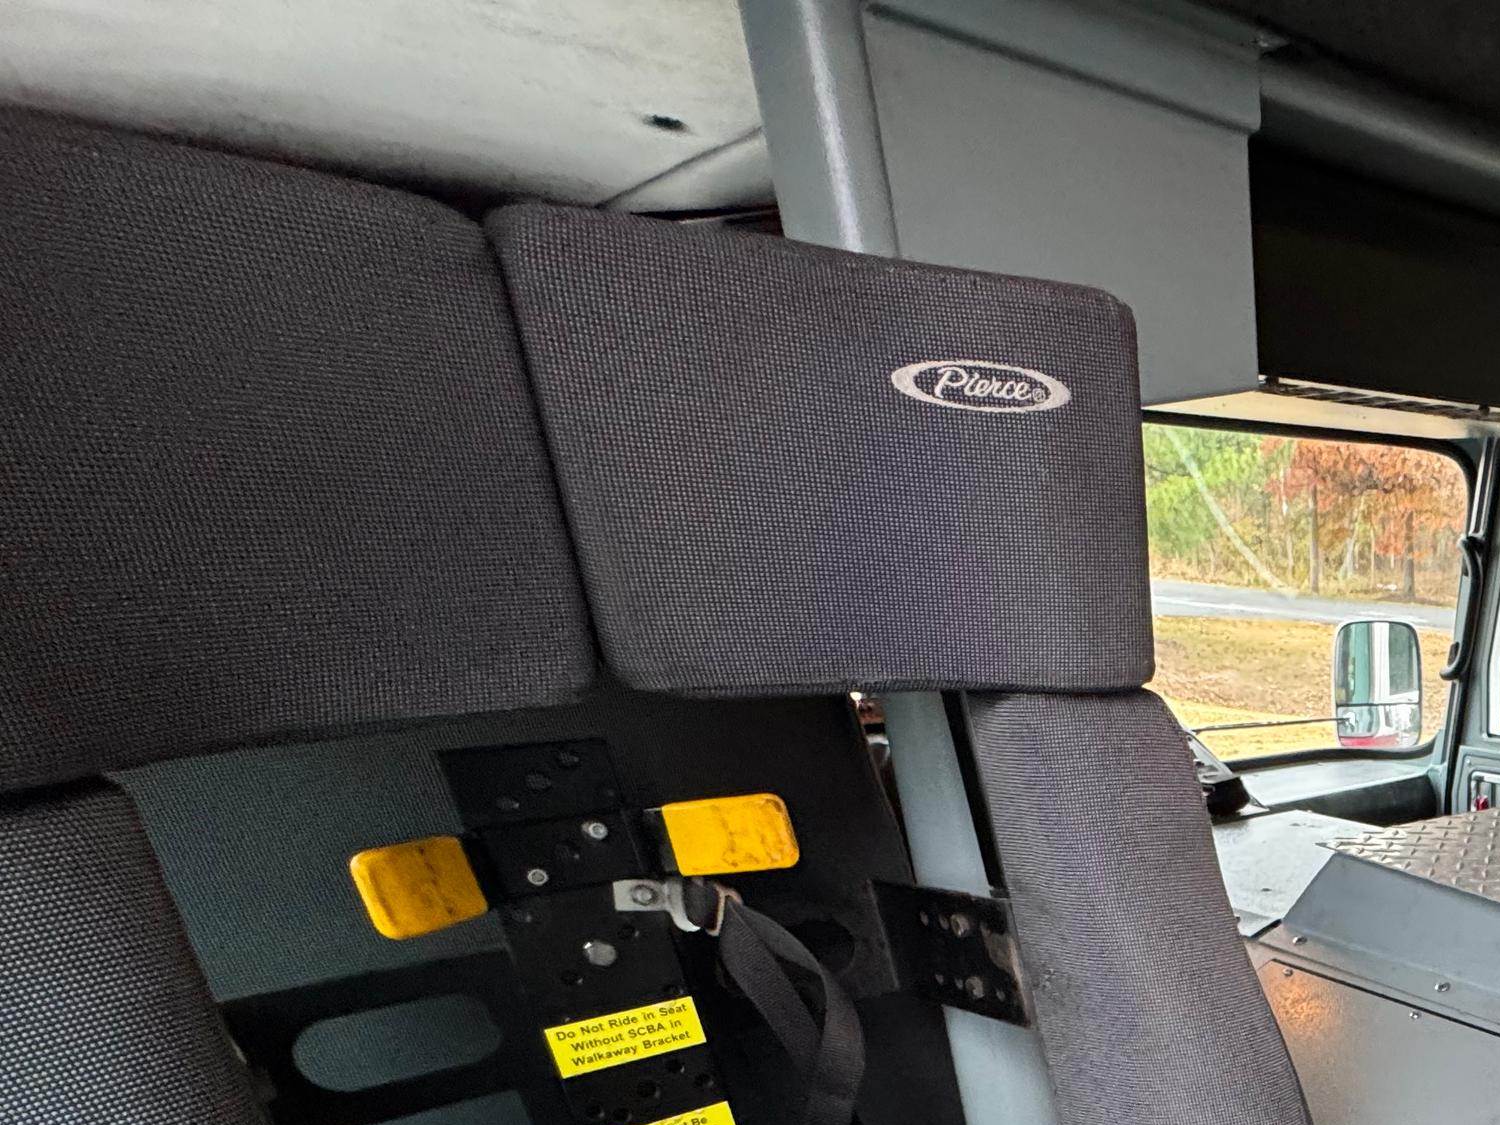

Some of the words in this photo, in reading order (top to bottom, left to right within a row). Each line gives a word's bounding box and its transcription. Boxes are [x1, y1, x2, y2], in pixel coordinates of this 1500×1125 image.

[933, 366, 1032, 400] Pierce
[556, 1031, 576, 1041] Do
[580, 1024, 604, 1036] Not
[608, 1015, 638, 1029] Ride
[643, 1011, 655, 1021] in
[659, 1003, 687, 1017] Seat
[570, 1033, 625, 1052] Without
[628, 1023, 666, 1039] SCBA
[670, 1019, 682, 1029] in
[571, 1044, 638, 1067] Walkaway
[643, 1030, 691, 1049] Bracket
